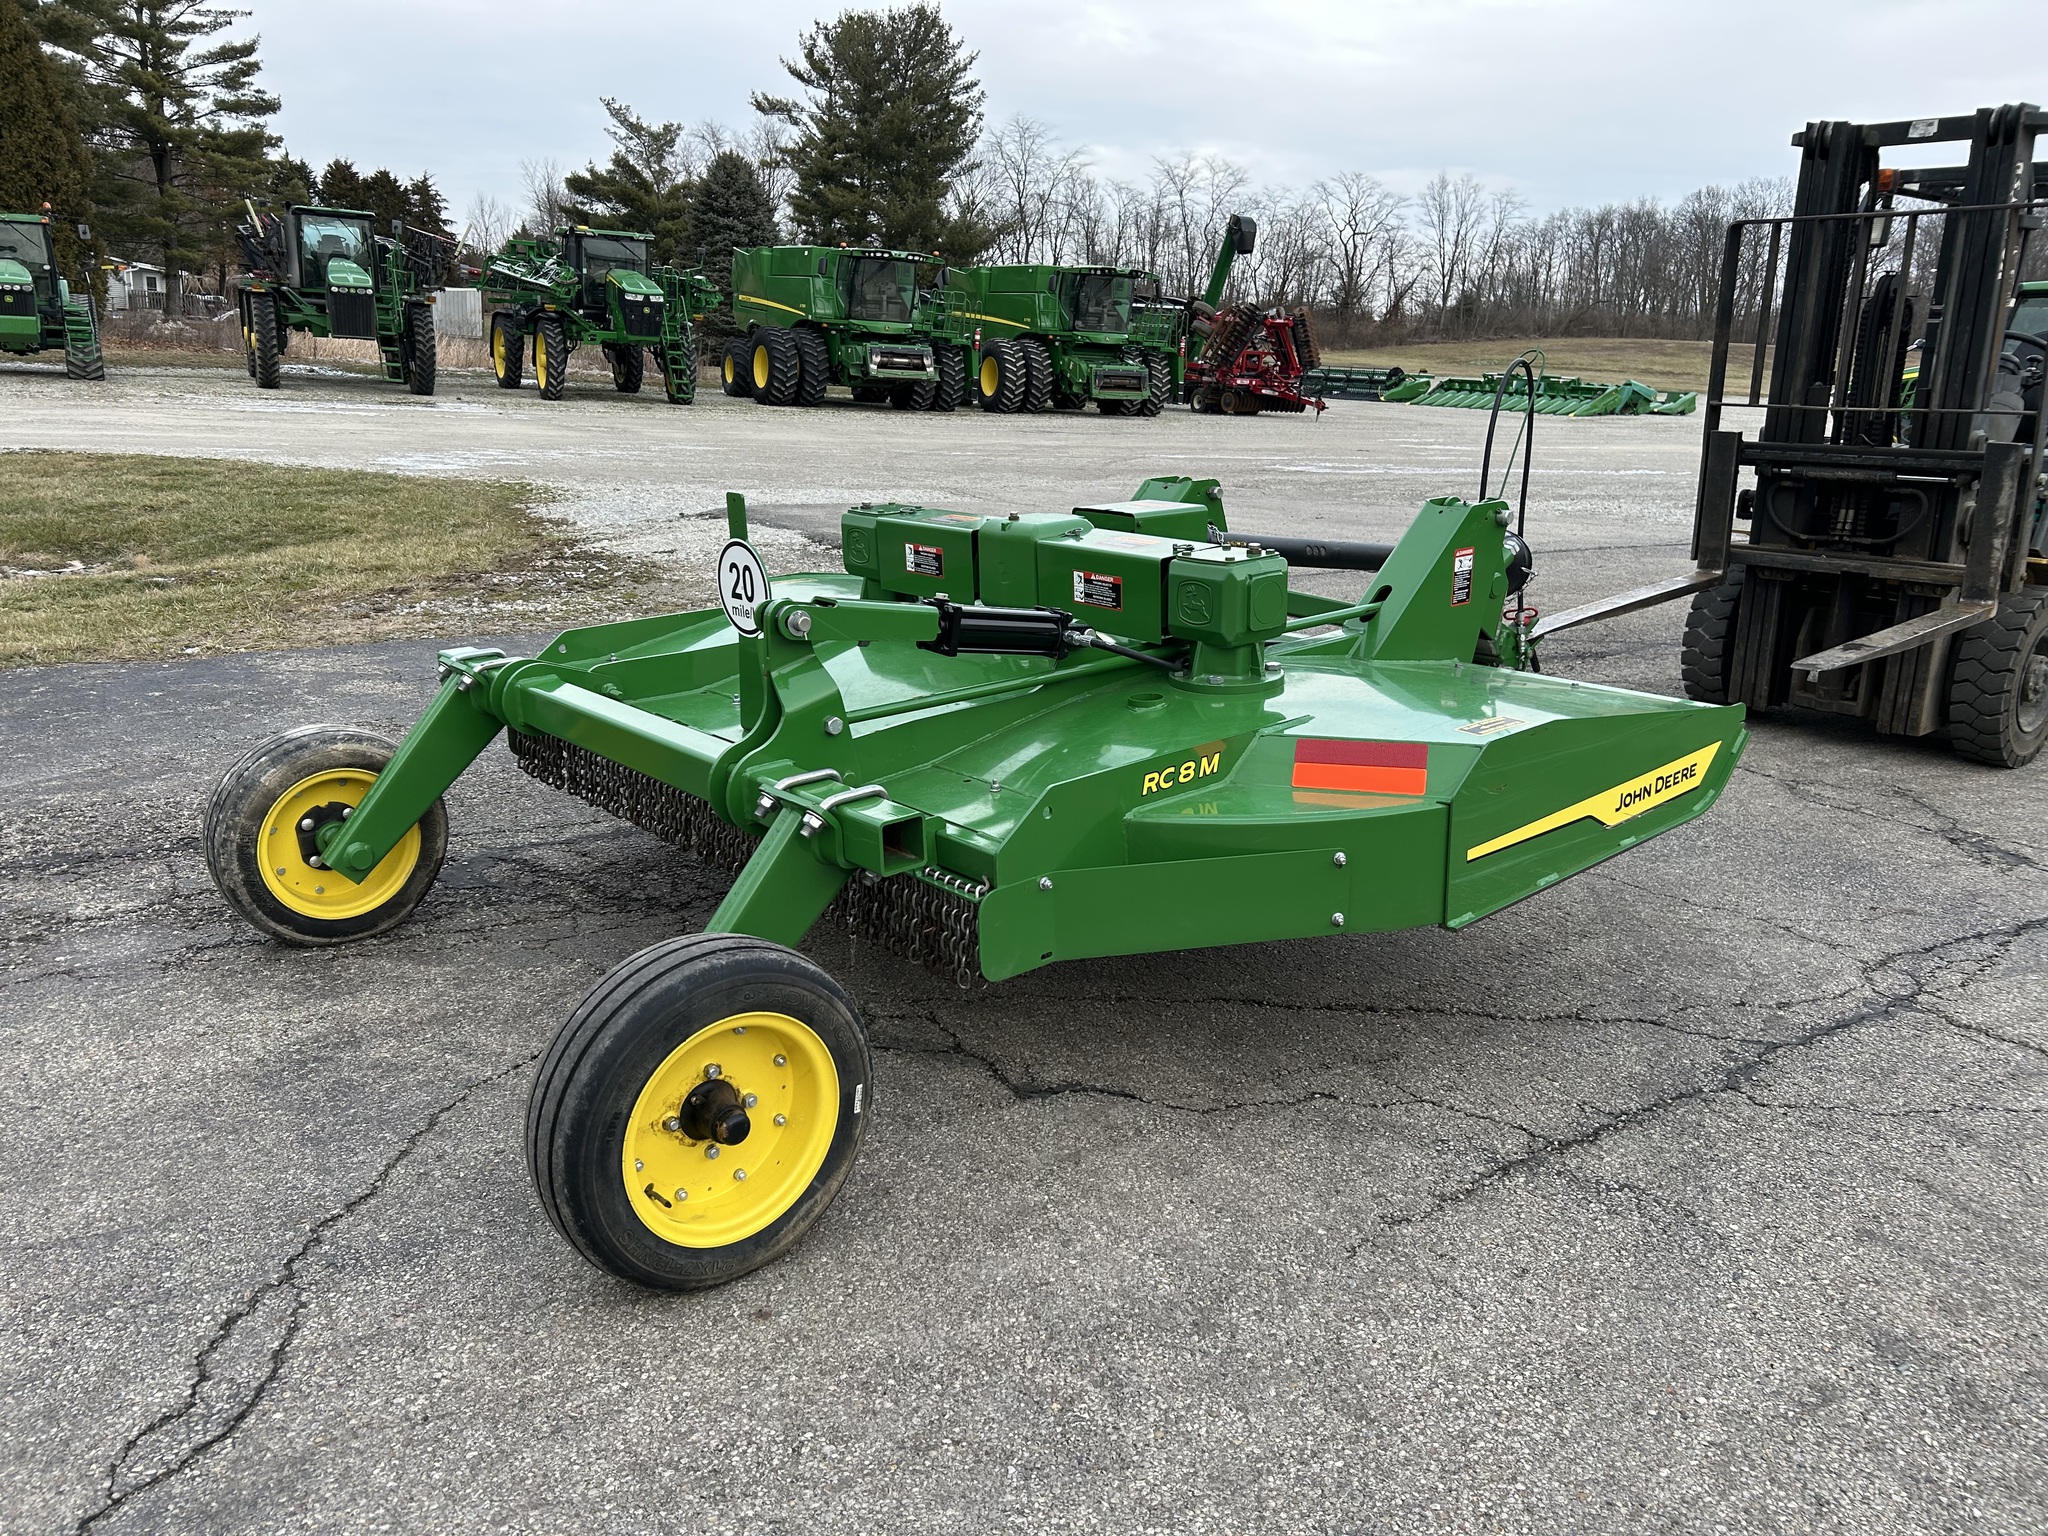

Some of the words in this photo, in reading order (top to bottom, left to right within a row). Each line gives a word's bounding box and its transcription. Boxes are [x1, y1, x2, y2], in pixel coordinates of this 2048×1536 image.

[729, 562, 754, 603] 20
[1096, 574, 1114, 583] DANGER
[732, 604, 754, 620] mile/
[769, 988, 854, 1053] ADVANCE
